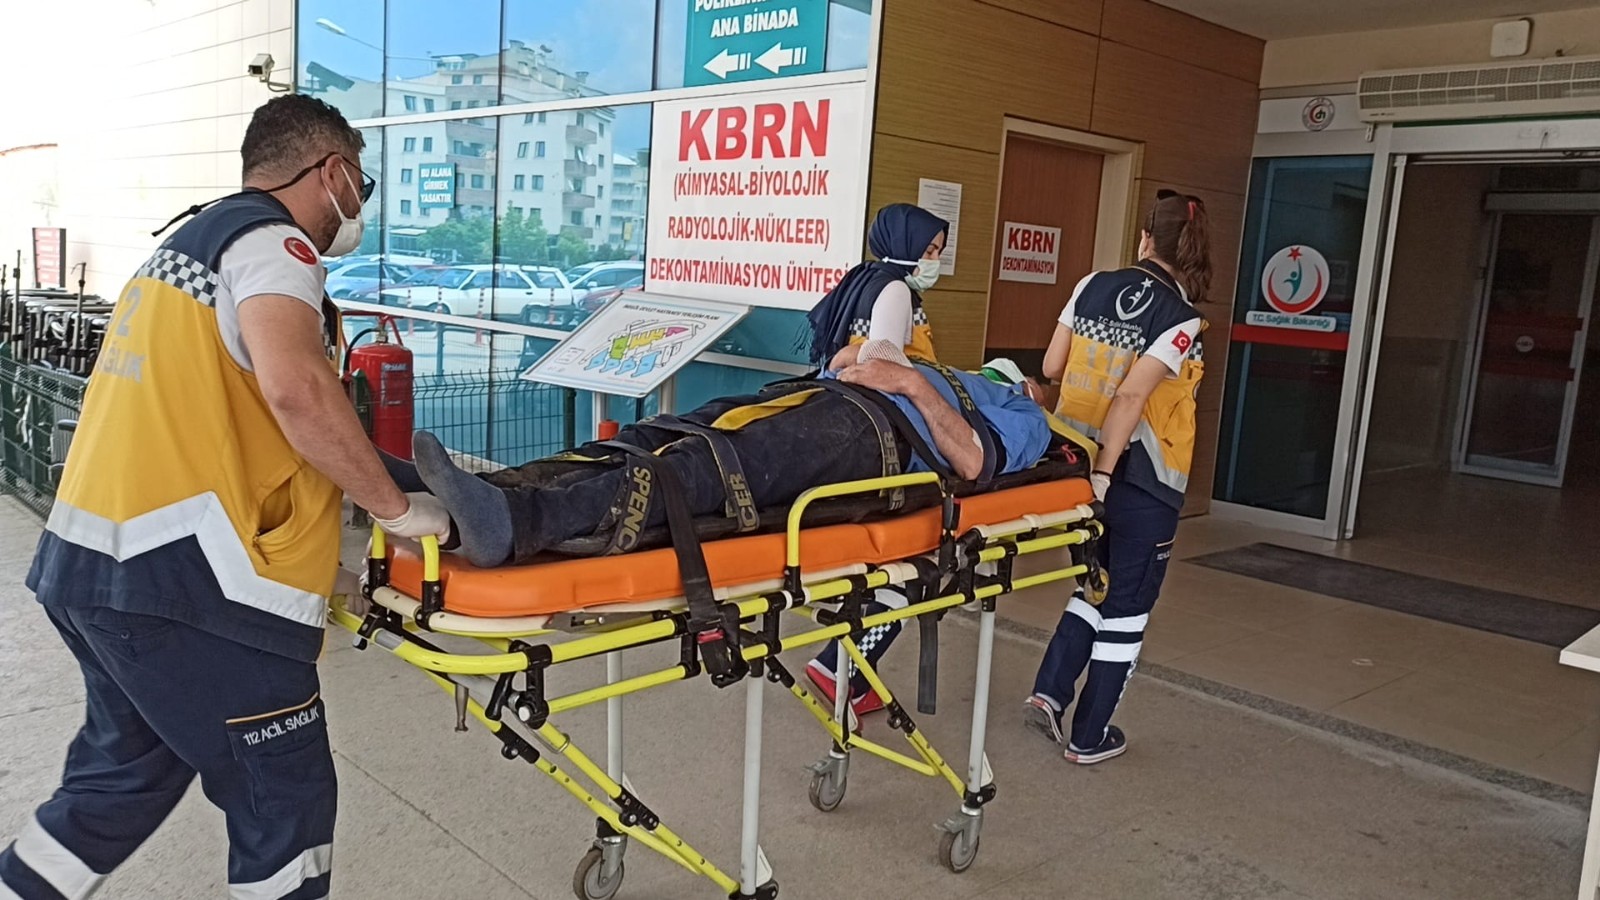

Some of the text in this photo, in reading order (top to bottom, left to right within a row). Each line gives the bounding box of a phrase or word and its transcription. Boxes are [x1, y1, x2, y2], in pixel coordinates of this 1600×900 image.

[710, 7, 799, 38] ANA BİNADA
[679, 99, 830, 161] KBRN
[674, 163, 830, 201] (KİMYASAL-BİYOLOJİK
[668, 211, 830, 252] RADYOLOJİK-NÜKLEER)
[1007, 226, 1055, 254] KBRN
[650, 256, 782, 290] DEKONTAMİNASYON
[243, 731, 261, 746] 112
[261, 721, 287, 742] ACİL
